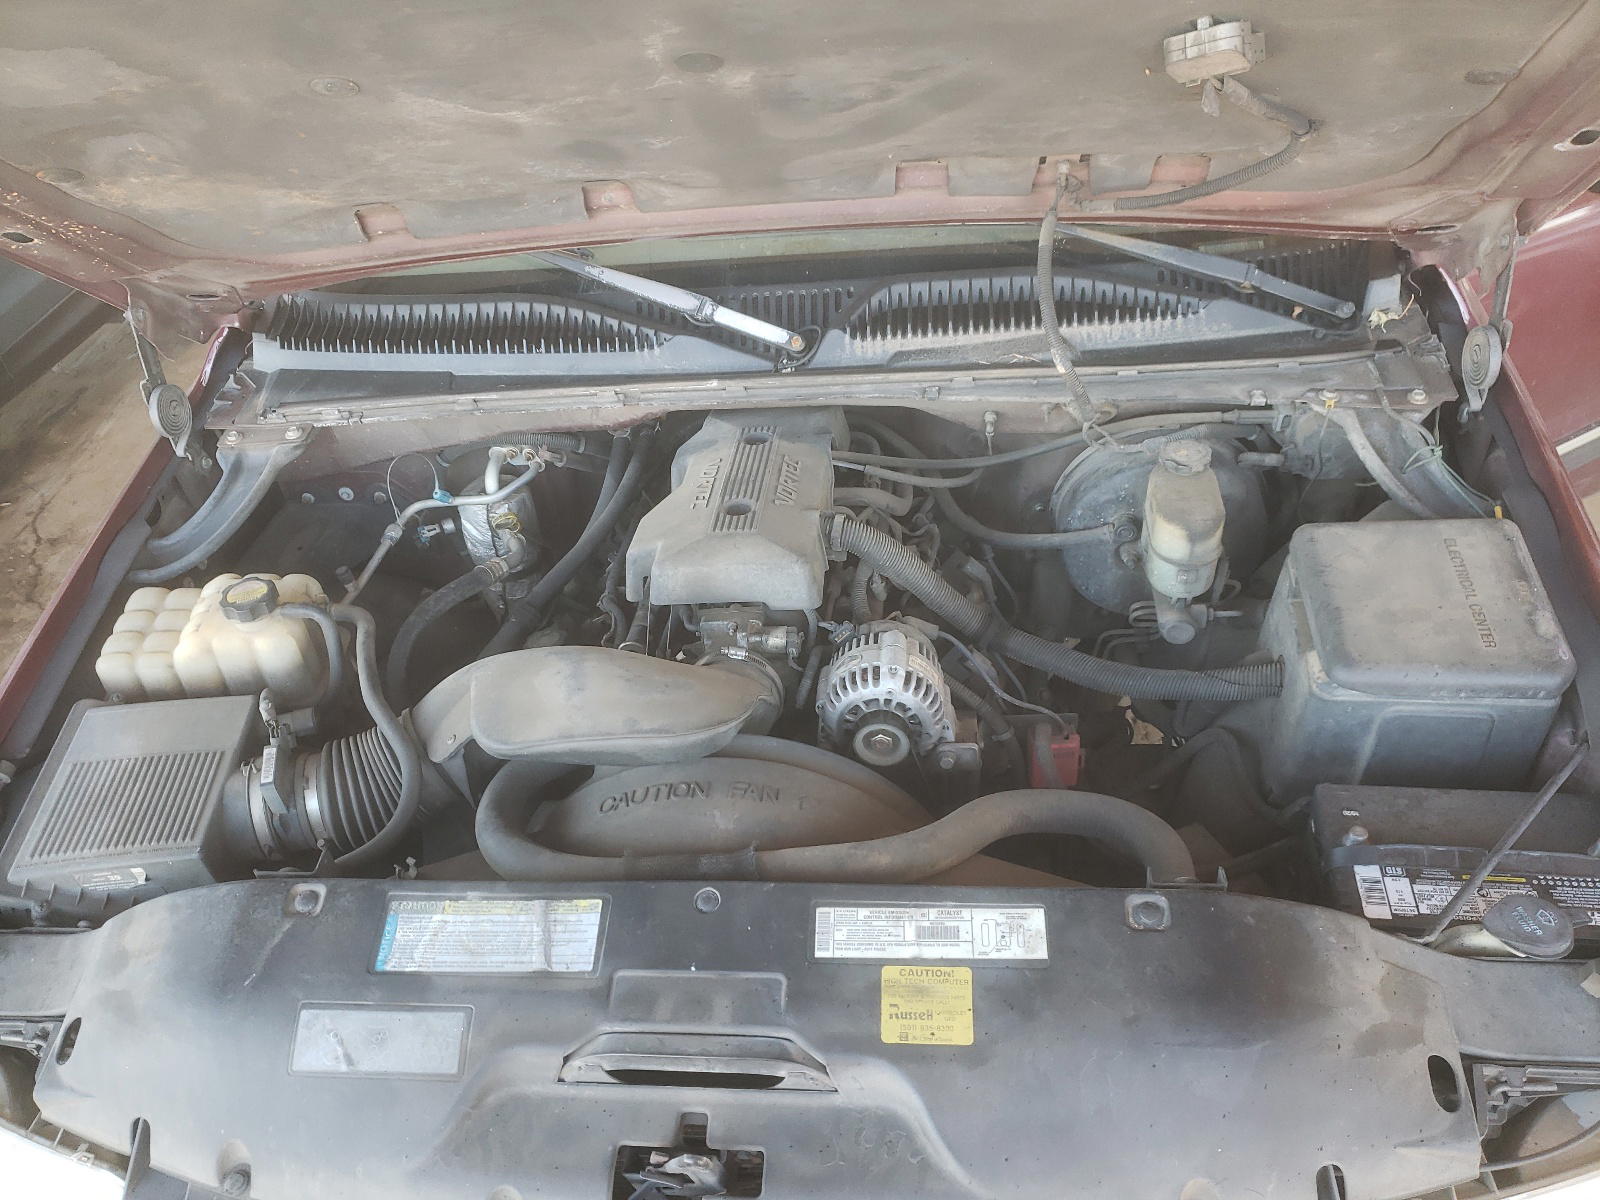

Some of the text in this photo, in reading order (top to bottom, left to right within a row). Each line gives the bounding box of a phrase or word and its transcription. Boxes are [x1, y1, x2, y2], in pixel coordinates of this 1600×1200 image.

[774, 454, 801, 506] VORTEC
[1443, 538, 1497, 648] ELECTRICAL CENTER
[599, 780, 711, 814] CAUTION
[728, 780, 780, 804] FAN
[1515, 905, 1543, 936] WASHER
[899, 968, 955, 978] CAUTION!
[927, 978, 969, 986] COMPUTER
